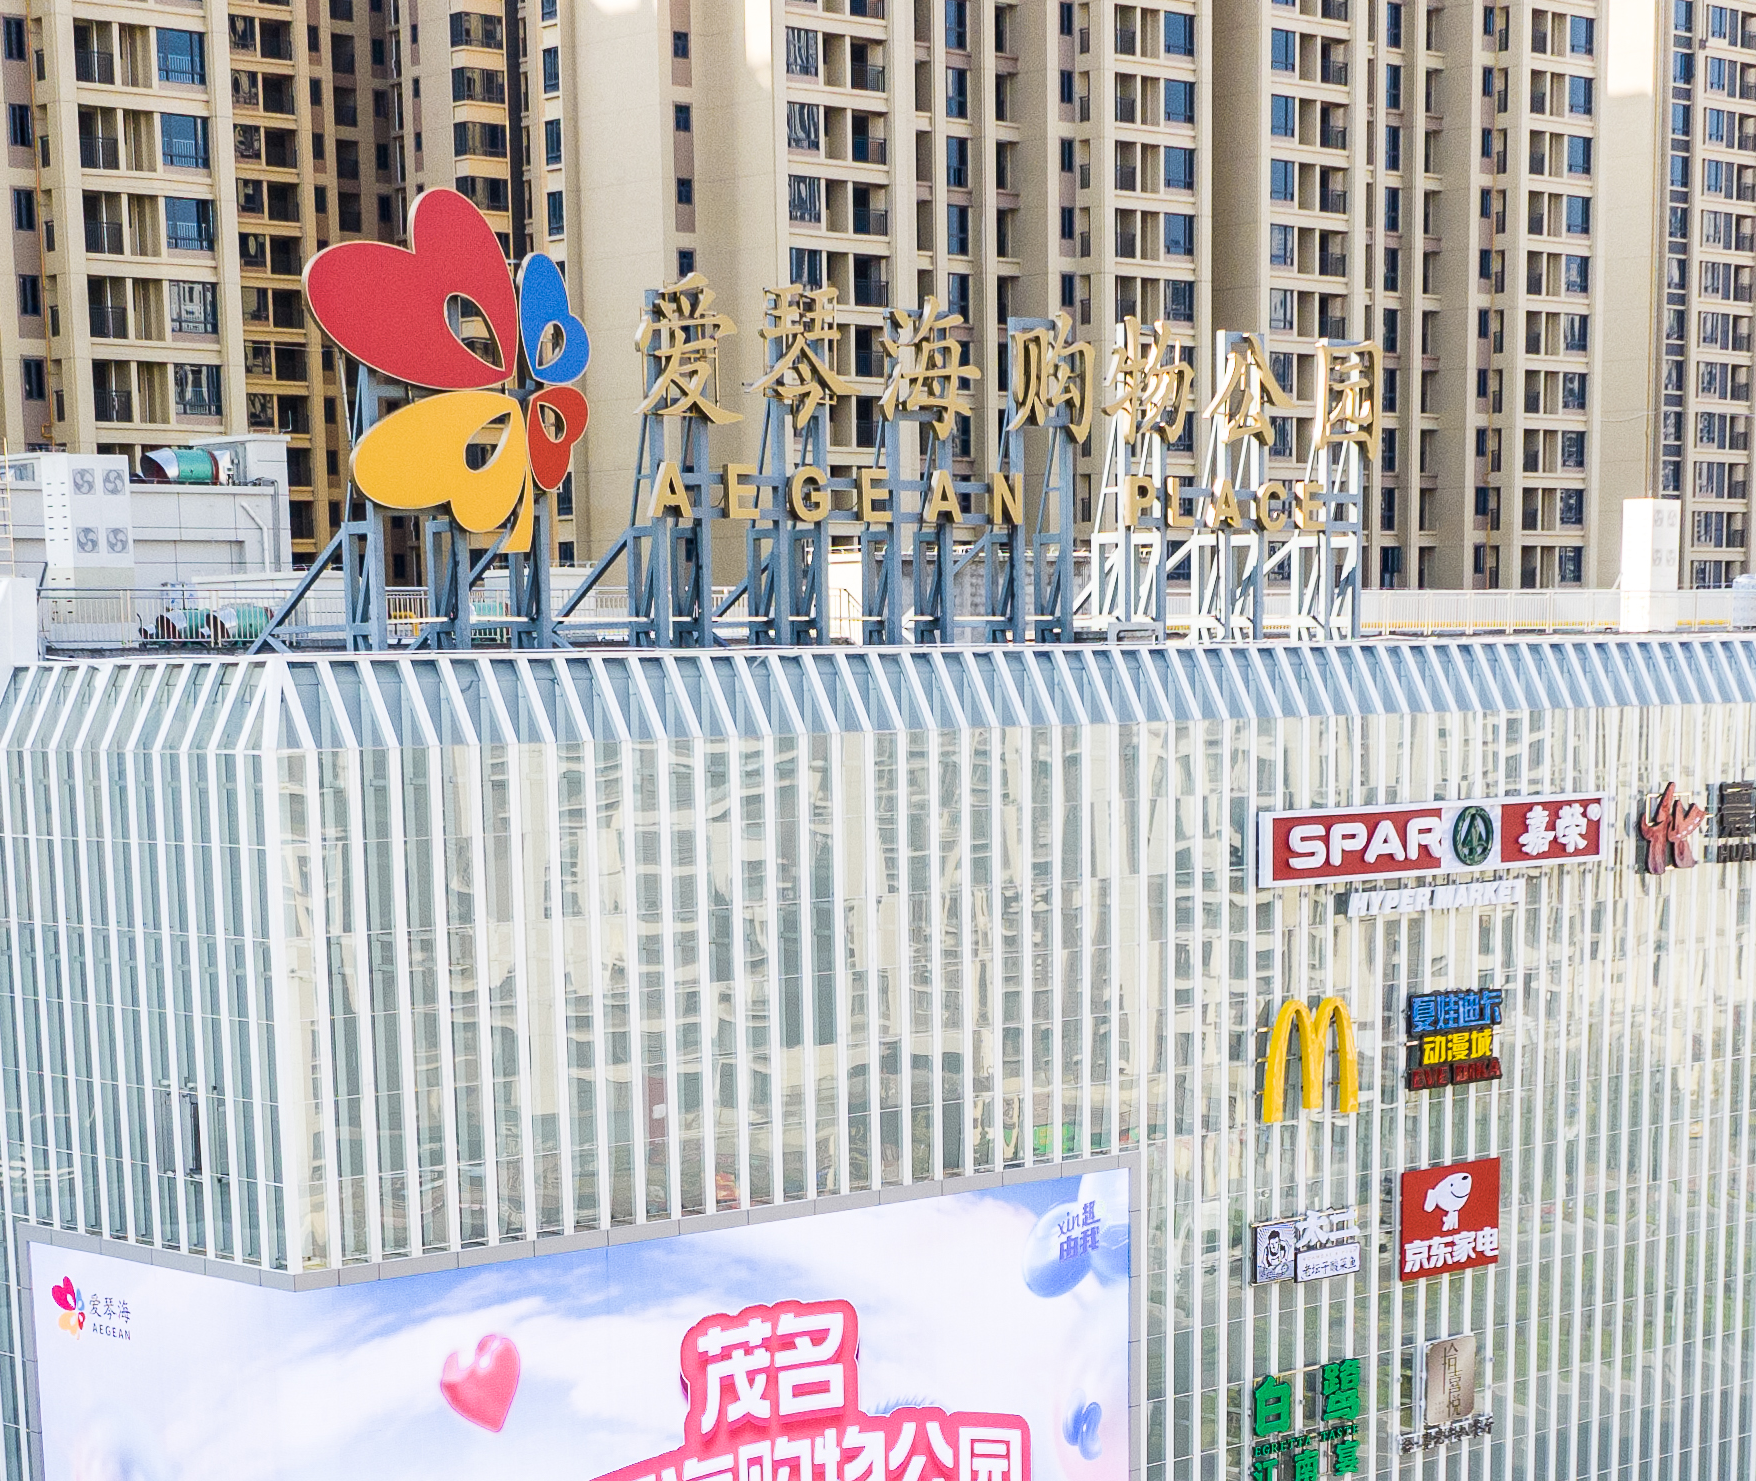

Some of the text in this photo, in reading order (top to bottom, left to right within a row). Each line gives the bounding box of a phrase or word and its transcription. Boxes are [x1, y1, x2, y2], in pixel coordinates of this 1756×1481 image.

[634, 272, 1383, 461] 爱琴海购物公园
[650, 459, 1327, 531] AEGEAN PLACE
[1288, 817, 1442, 870] SPAR
[1518, 803, 1587, 856] 嘉荣
[1348, 880, 1524, 918] HYPER MARKET
[1423, 1028, 1492, 1065] 动漫城
[1404, 1226, 1499, 1273] 京东家电
[88, 1293, 132, 1324] 爱琴海
[91, 1322, 131, 1341] AEGEAN
[696, 1309, 846, 1434] 茂名
[1255, 1358, 1361, 1436] 白鹭
[1255, 1424, 1359, 1458] EGRETTA TASTE
